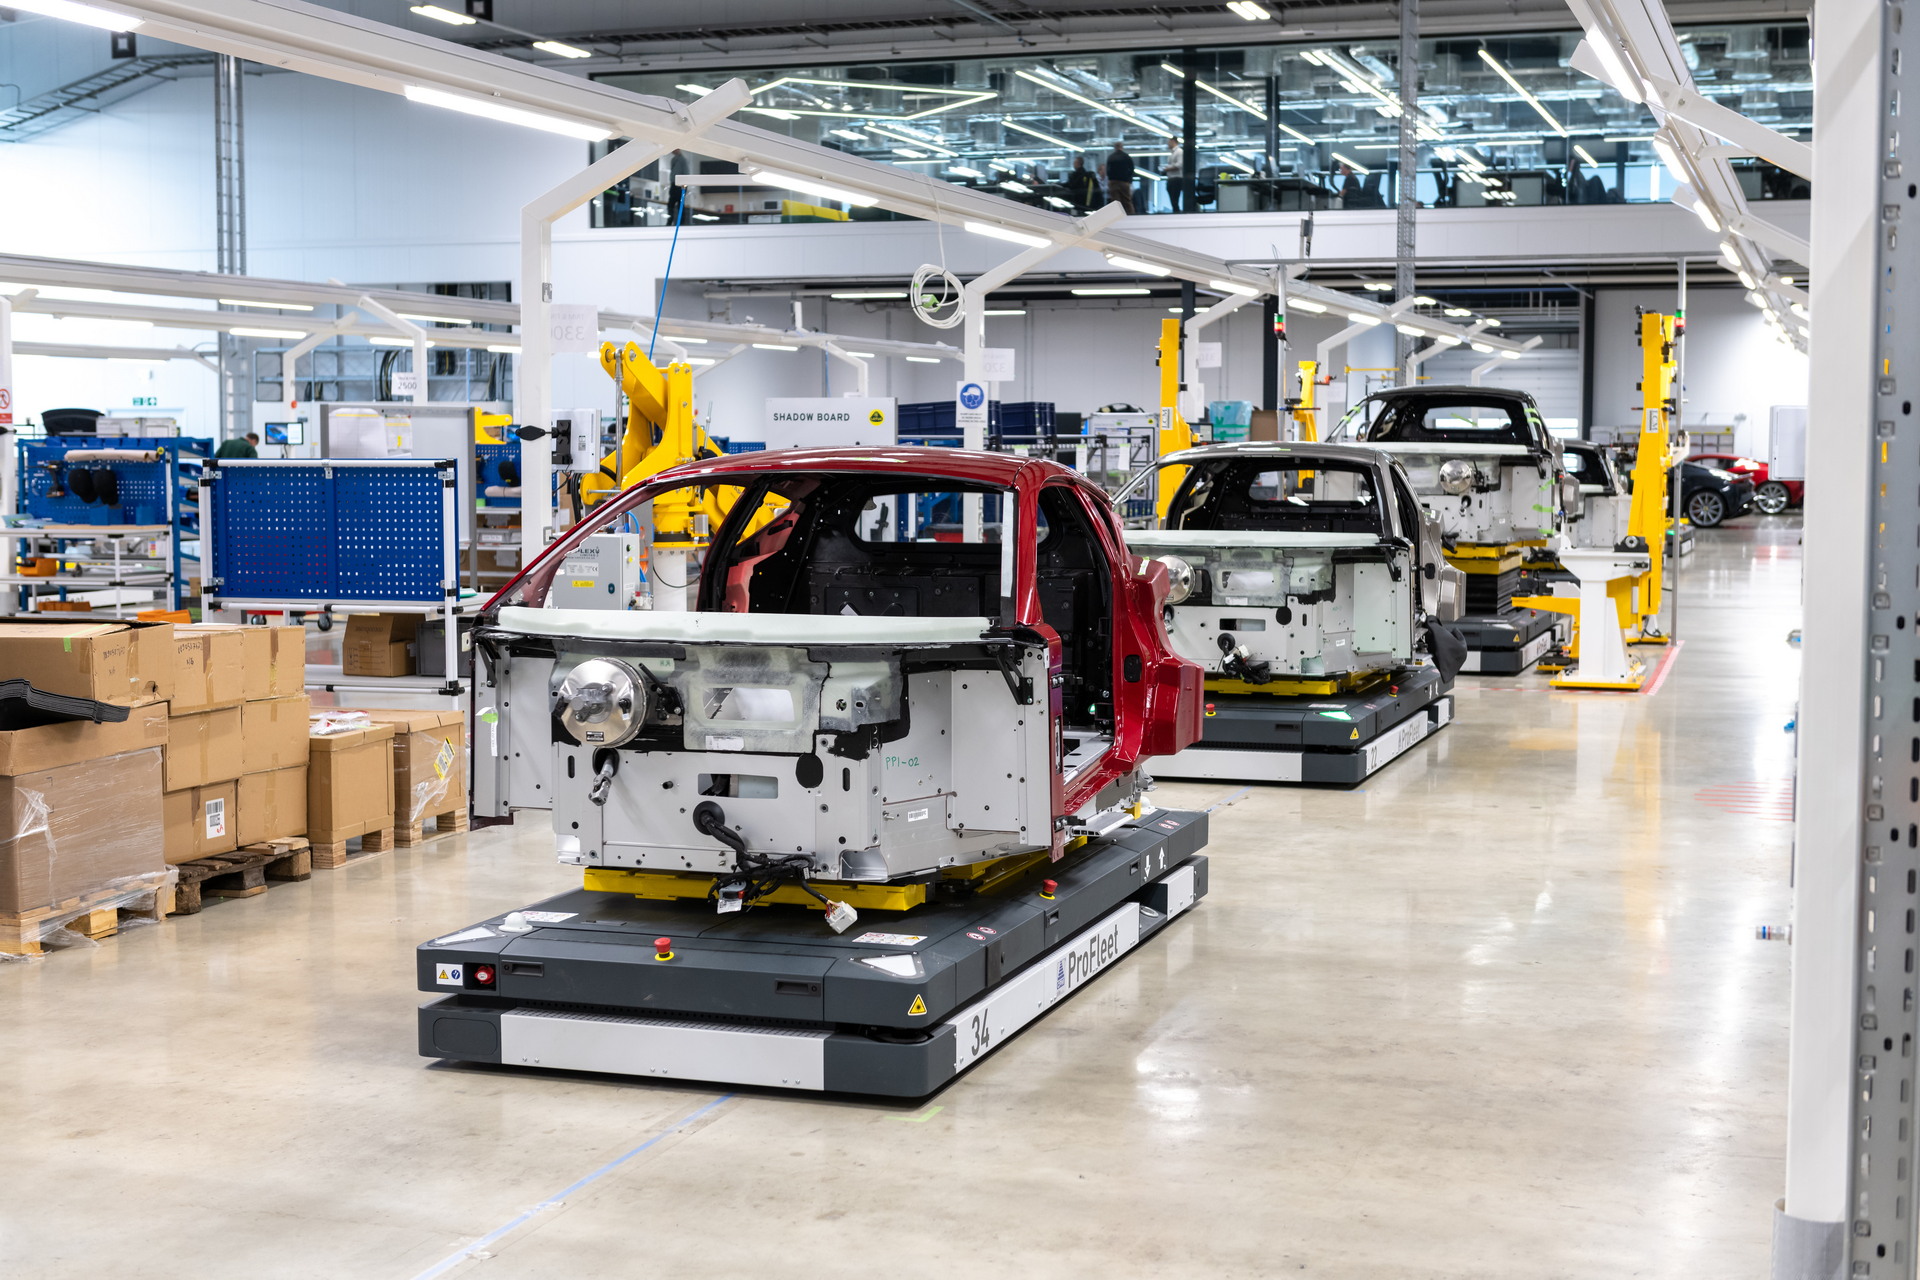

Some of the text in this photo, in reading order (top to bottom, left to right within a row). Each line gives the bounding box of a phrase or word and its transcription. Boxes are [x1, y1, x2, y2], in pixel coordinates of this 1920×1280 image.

[773, 413, 850, 421] SHADOW BOARD
[1067, 923, 1119, 989] ProFleet
[971, 1007, 990, 1057] 34
